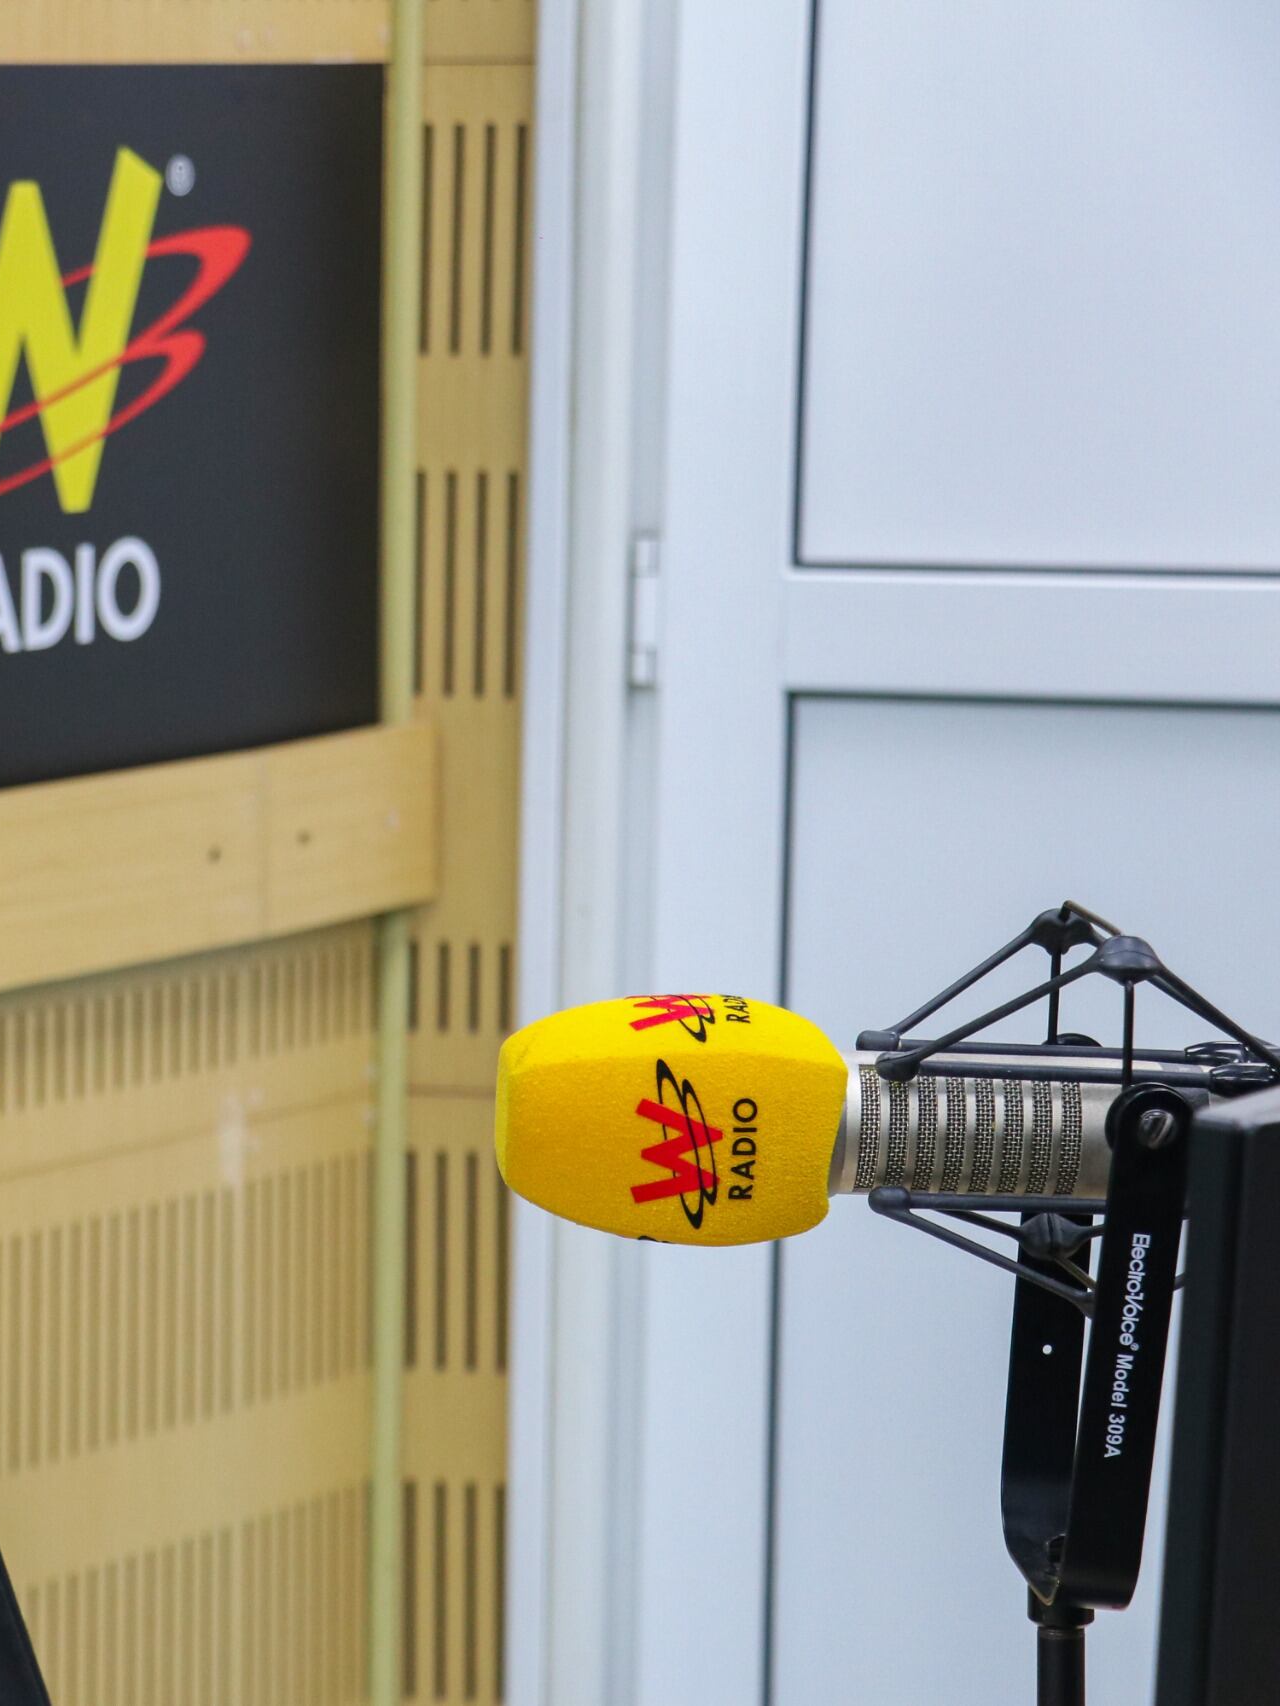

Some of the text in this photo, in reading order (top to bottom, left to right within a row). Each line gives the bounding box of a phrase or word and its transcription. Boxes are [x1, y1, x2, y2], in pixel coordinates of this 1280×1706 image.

[630, 1098, 724, 1204] W
[728, 1098, 758, 1201] RADIO
[1111, 1354, 1134, 1408] Model
[1104, 1413, 1126, 1459] 309A
